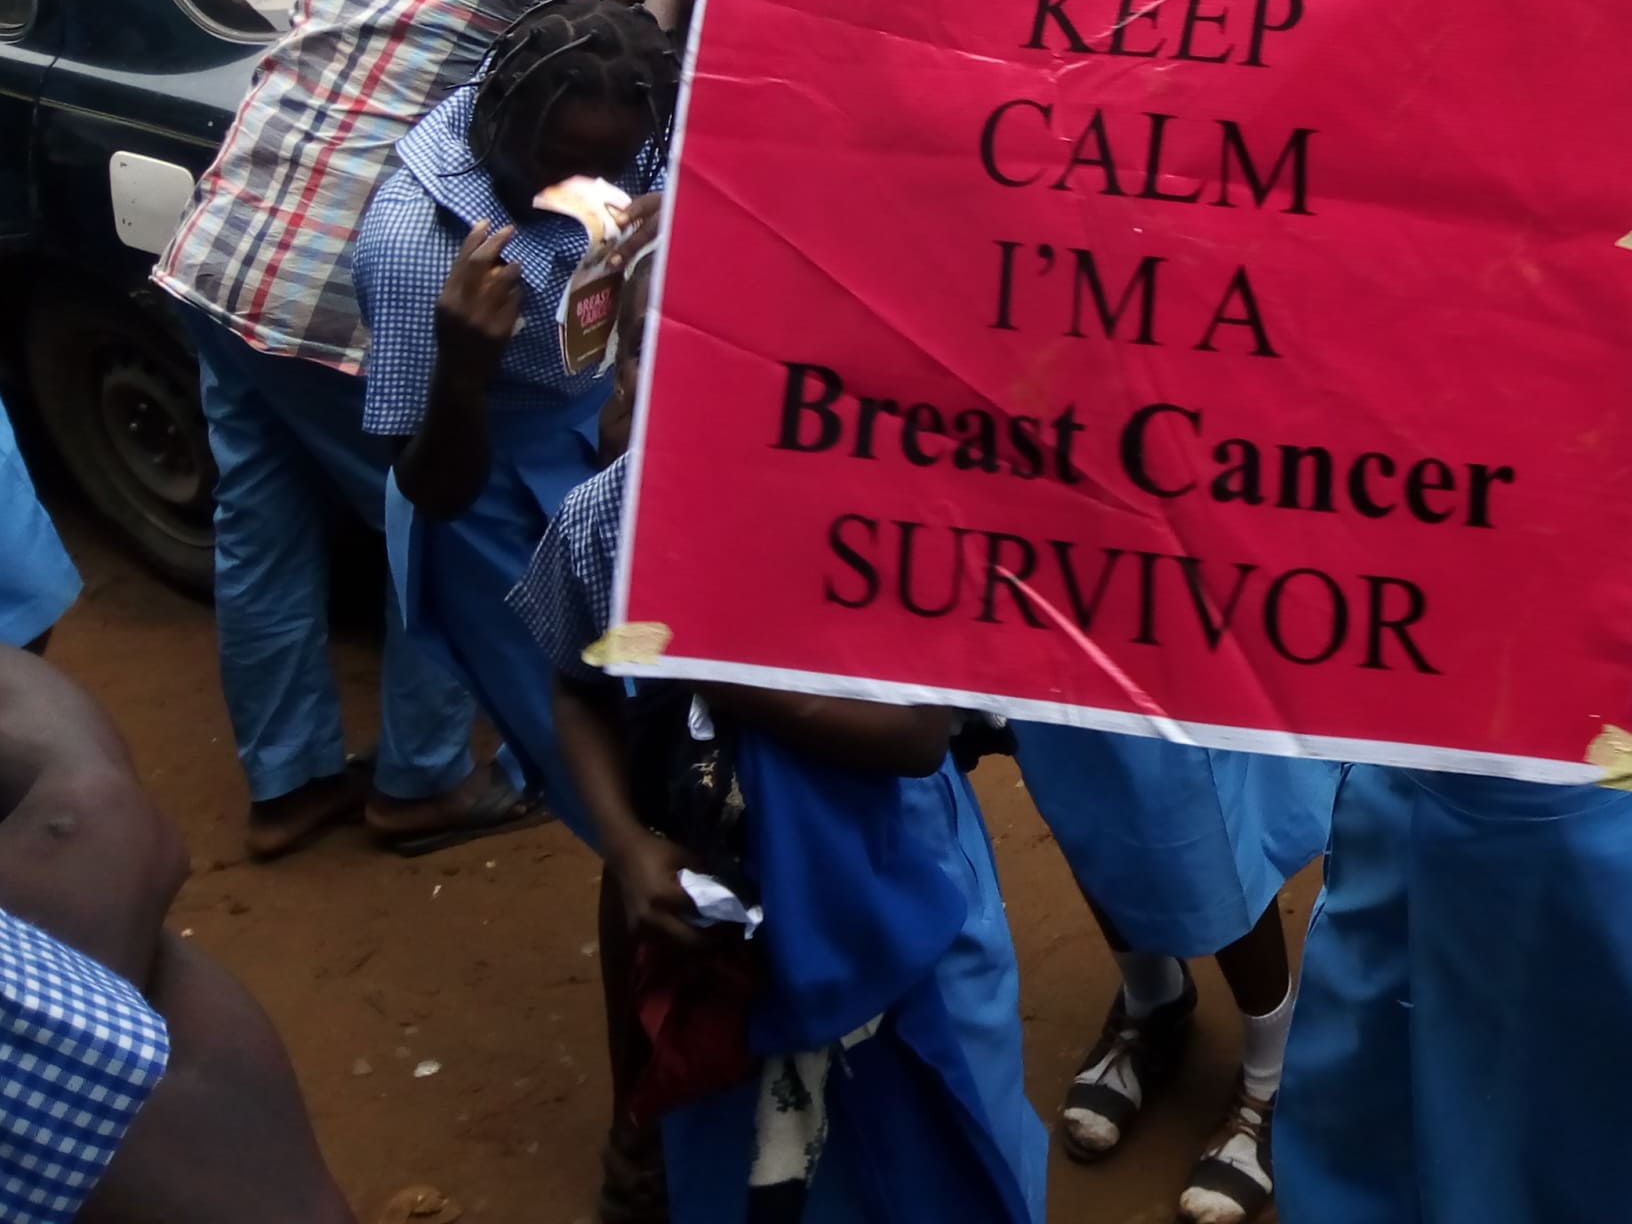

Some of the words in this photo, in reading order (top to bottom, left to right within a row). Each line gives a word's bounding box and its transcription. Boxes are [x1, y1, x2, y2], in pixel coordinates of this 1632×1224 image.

[979, 98, 1320, 217] CALM
[1191, 263, 1285, 359] A
[769, 360, 1087, 485] Breast
[1117, 401, 1516, 530] Cancer
[823, 512, 1446, 676] SURVIVOR
